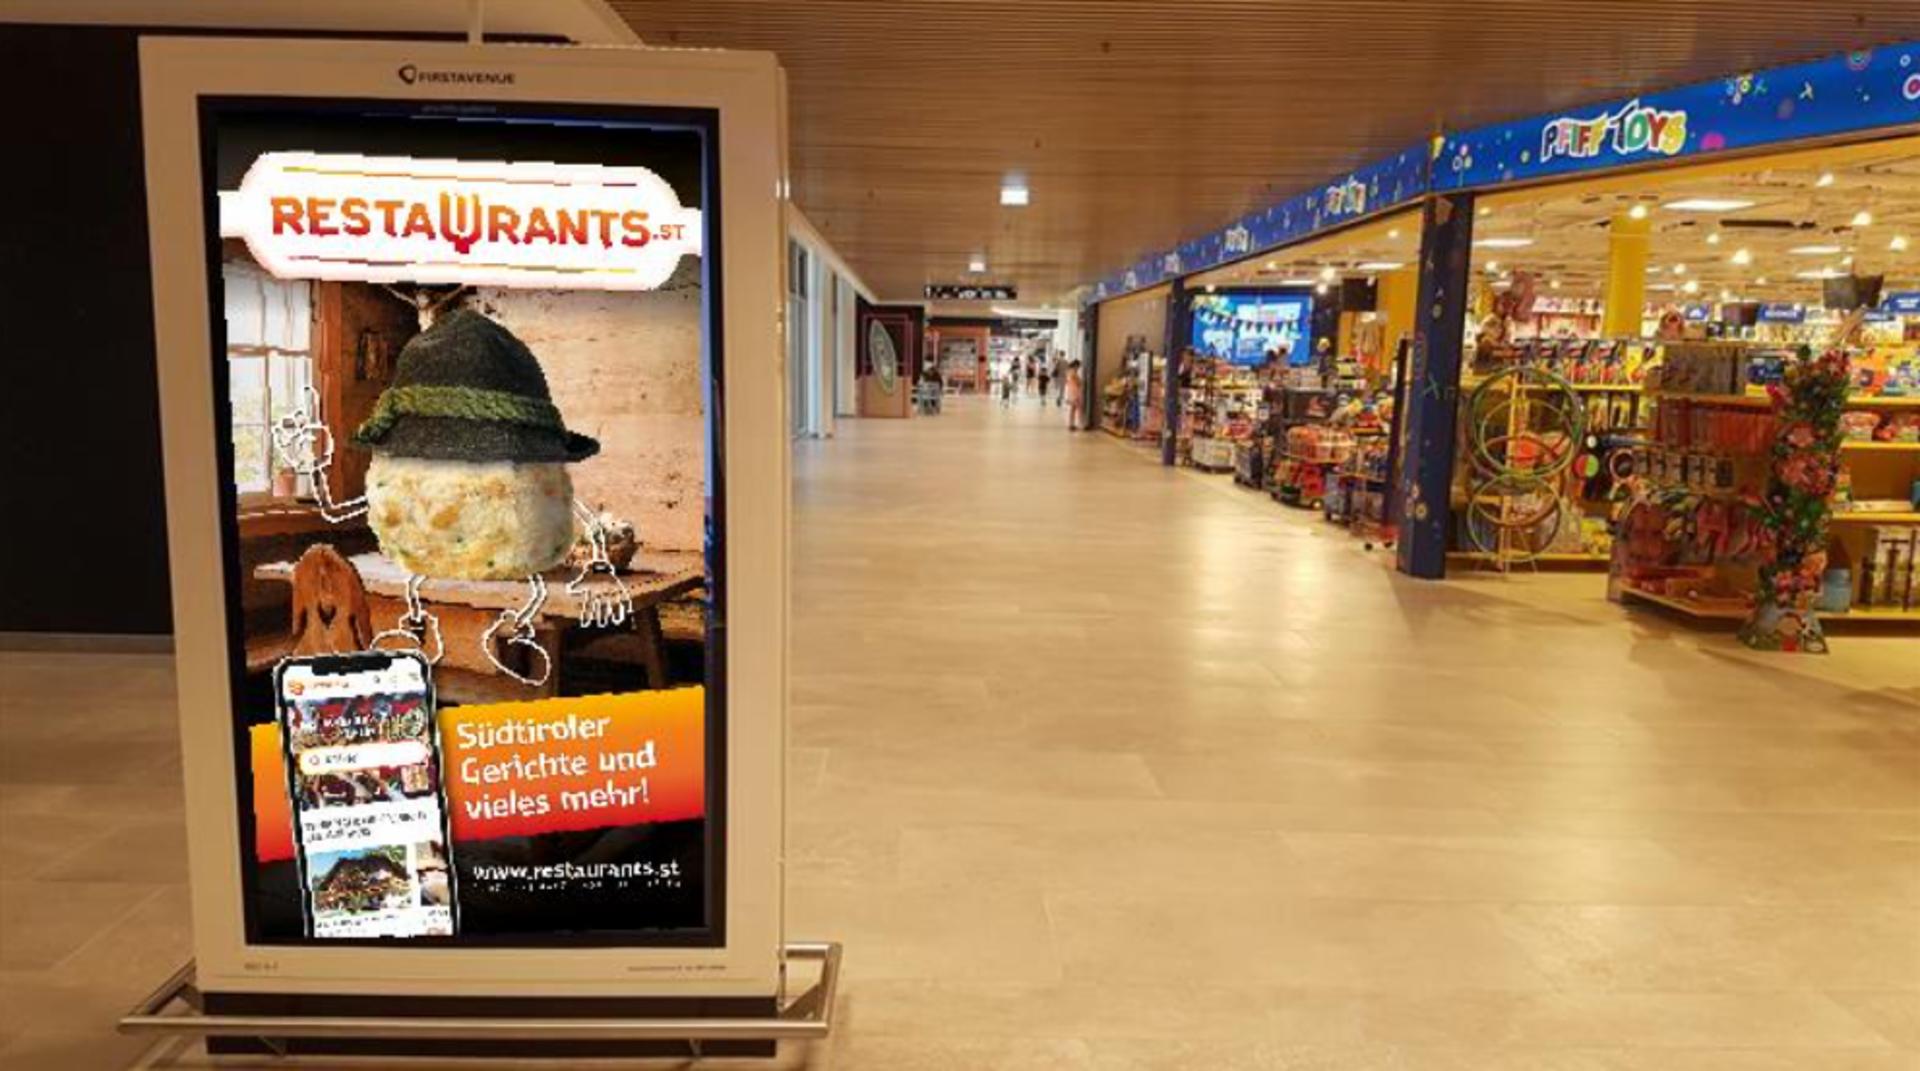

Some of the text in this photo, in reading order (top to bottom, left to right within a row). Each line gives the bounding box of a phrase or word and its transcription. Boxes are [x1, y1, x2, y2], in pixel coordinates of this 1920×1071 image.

[418, 71, 516, 85] FIRSTAVENUE
[1540, 98, 1688, 164] PFIFF TOYS
[456, 713, 612, 750] Südtiroler
[461, 740, 658, 785] Gerichte und
[465, 777, 651, 820] vieles mehr!
[473, 859, 682, 881] www.restaurants.st
